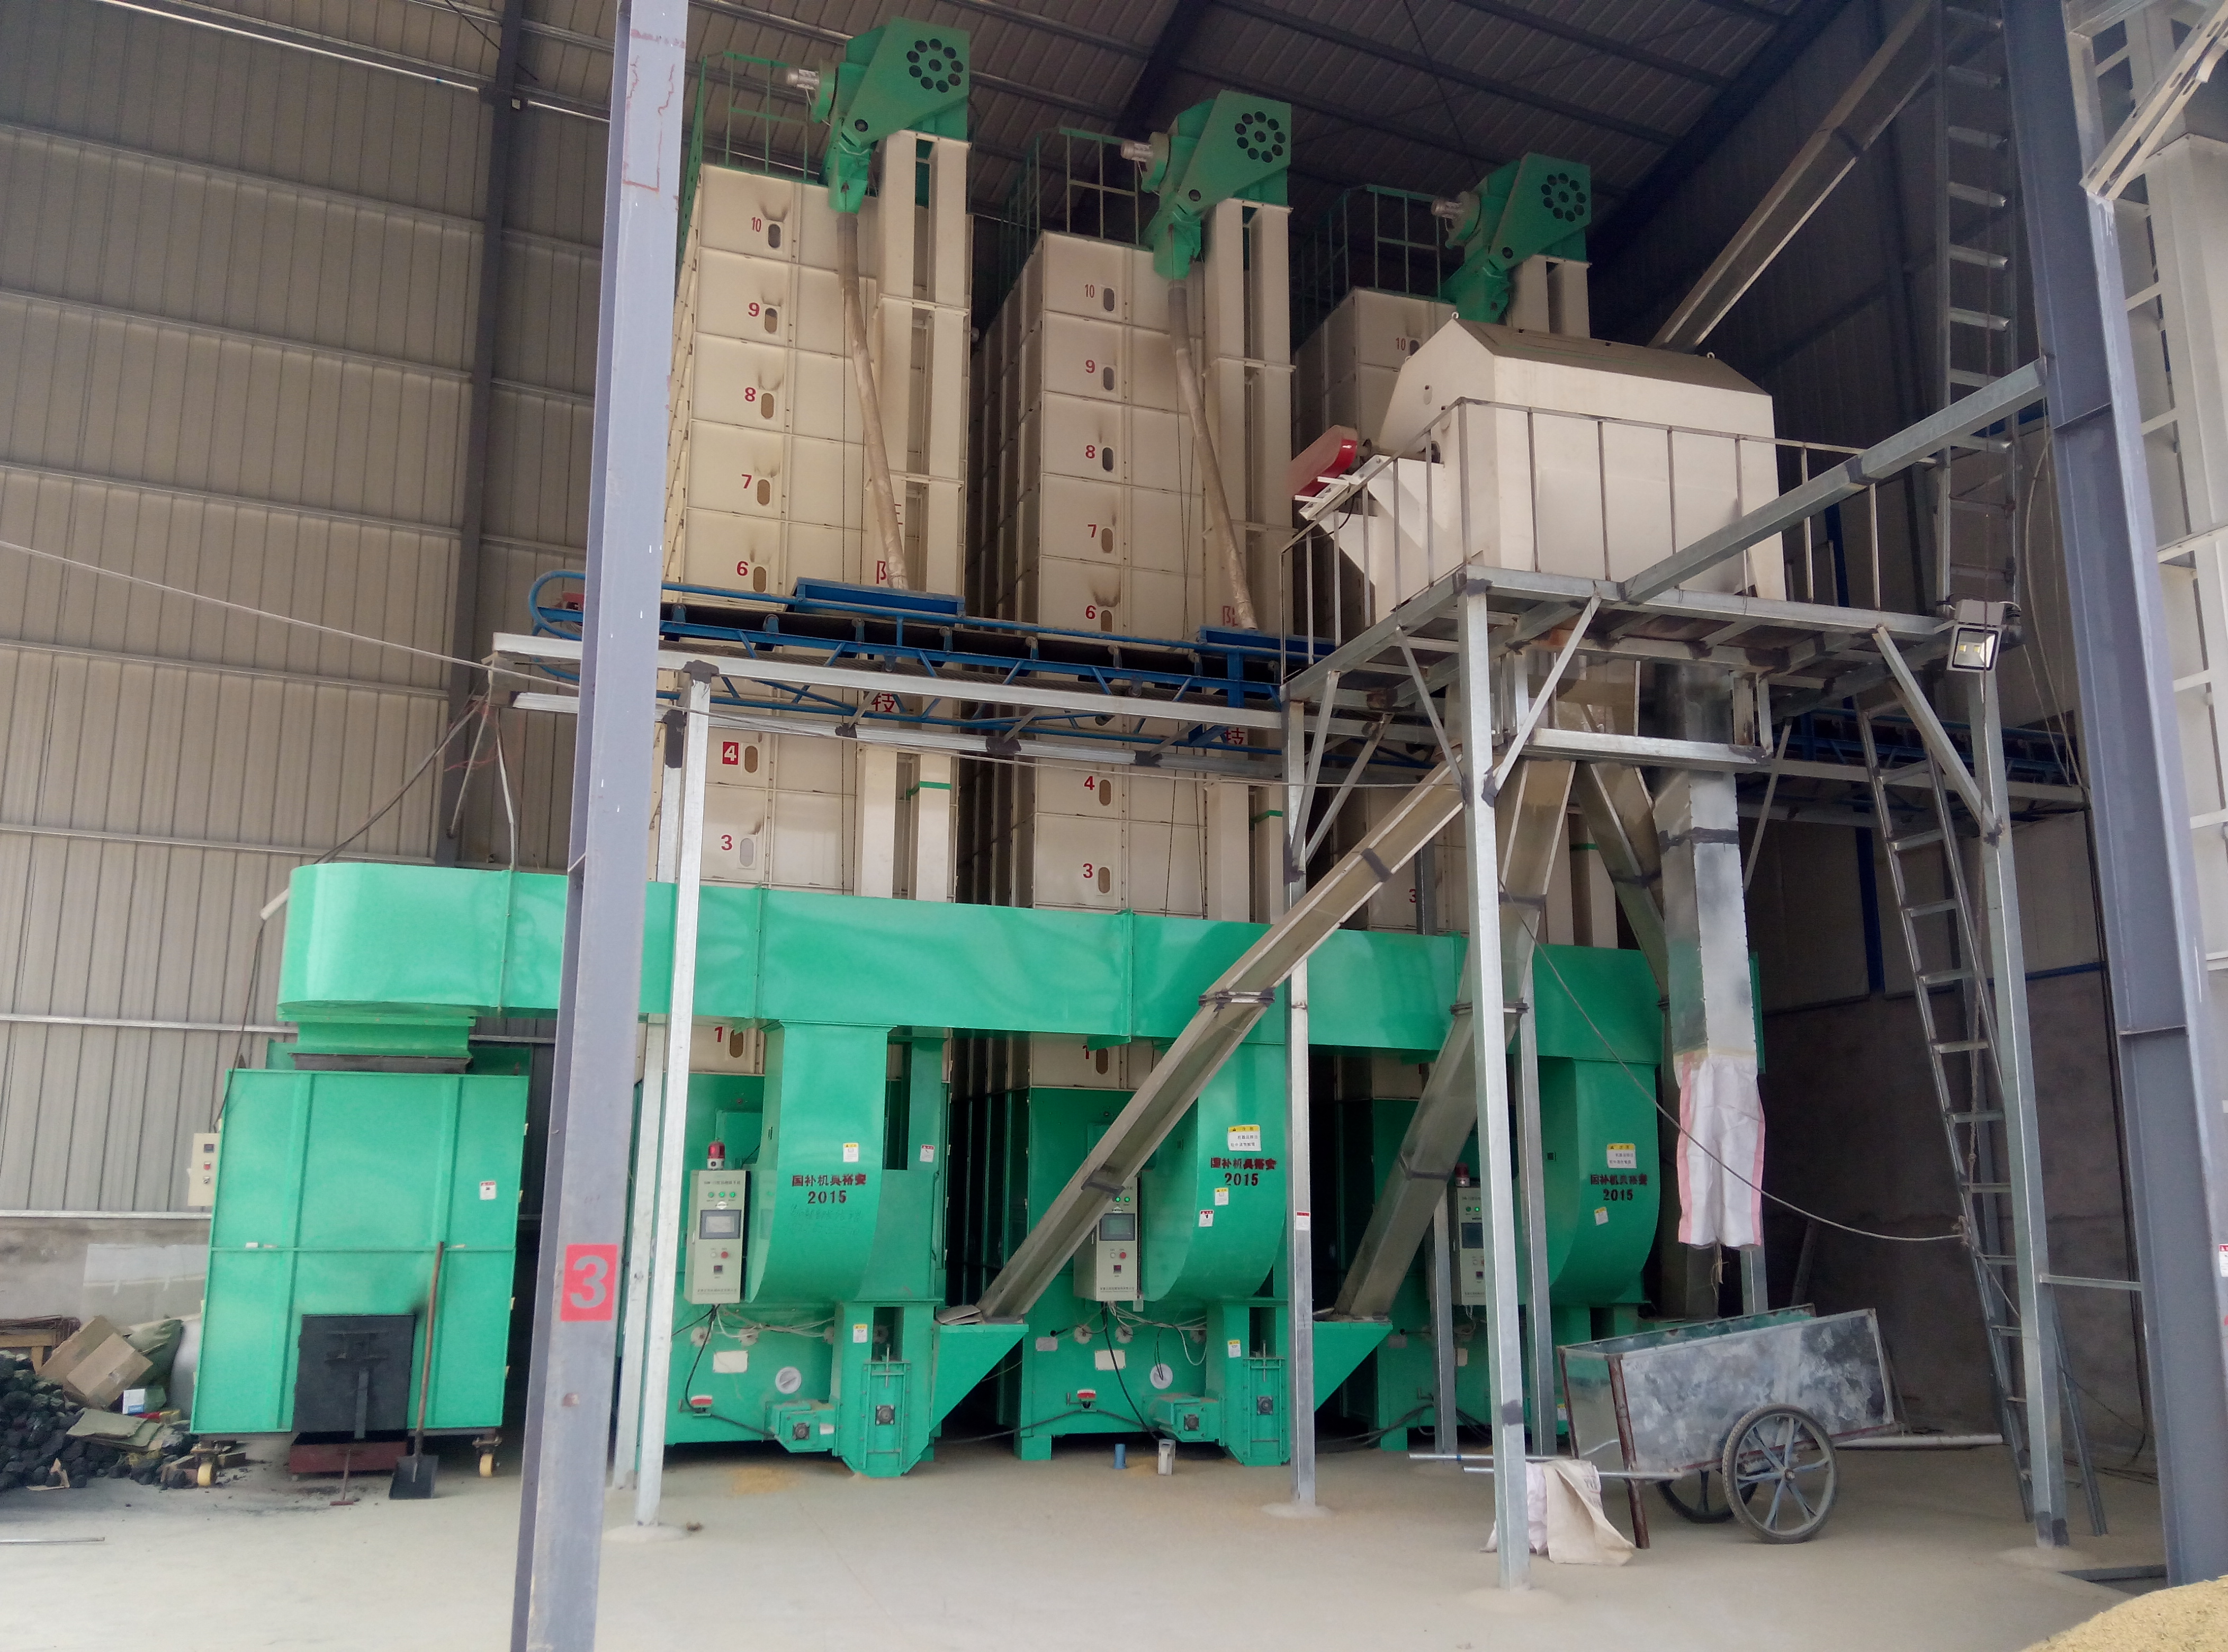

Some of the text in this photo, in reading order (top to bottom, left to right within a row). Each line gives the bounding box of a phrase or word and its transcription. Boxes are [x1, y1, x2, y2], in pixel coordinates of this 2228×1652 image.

[751, 217, 762, 232] 10
[1084, 284, 1096, 298] 10
[748, 302, 761, 317] 9
[1395, 337, 1407, 351] 10
[1085, 360, 1096, 374] 9
[744, 387, 757, 402] 8
[1085, 445, 1097, 459] 8
[742, 474, 752, 489] 7
[1087, 524, 1098, 538] 7
[736, 561, 749, 576] 6
[1085, 605, 1097, 620] 6
[724, 744, 737, 761] 4
[1083, 776, 1095, 791] 4
[721, 834, 733, 851] 3
[1082, 863, 1094, 878] 3
[714, 1026, 723, 1043] 1
[1224, 1172, 1259, 1186] 2015
[807, 1189, 847, 1204] 2015
[1603, 1188, 1633, 1201] 2015
[570, 1255, 608, 1309] 3
